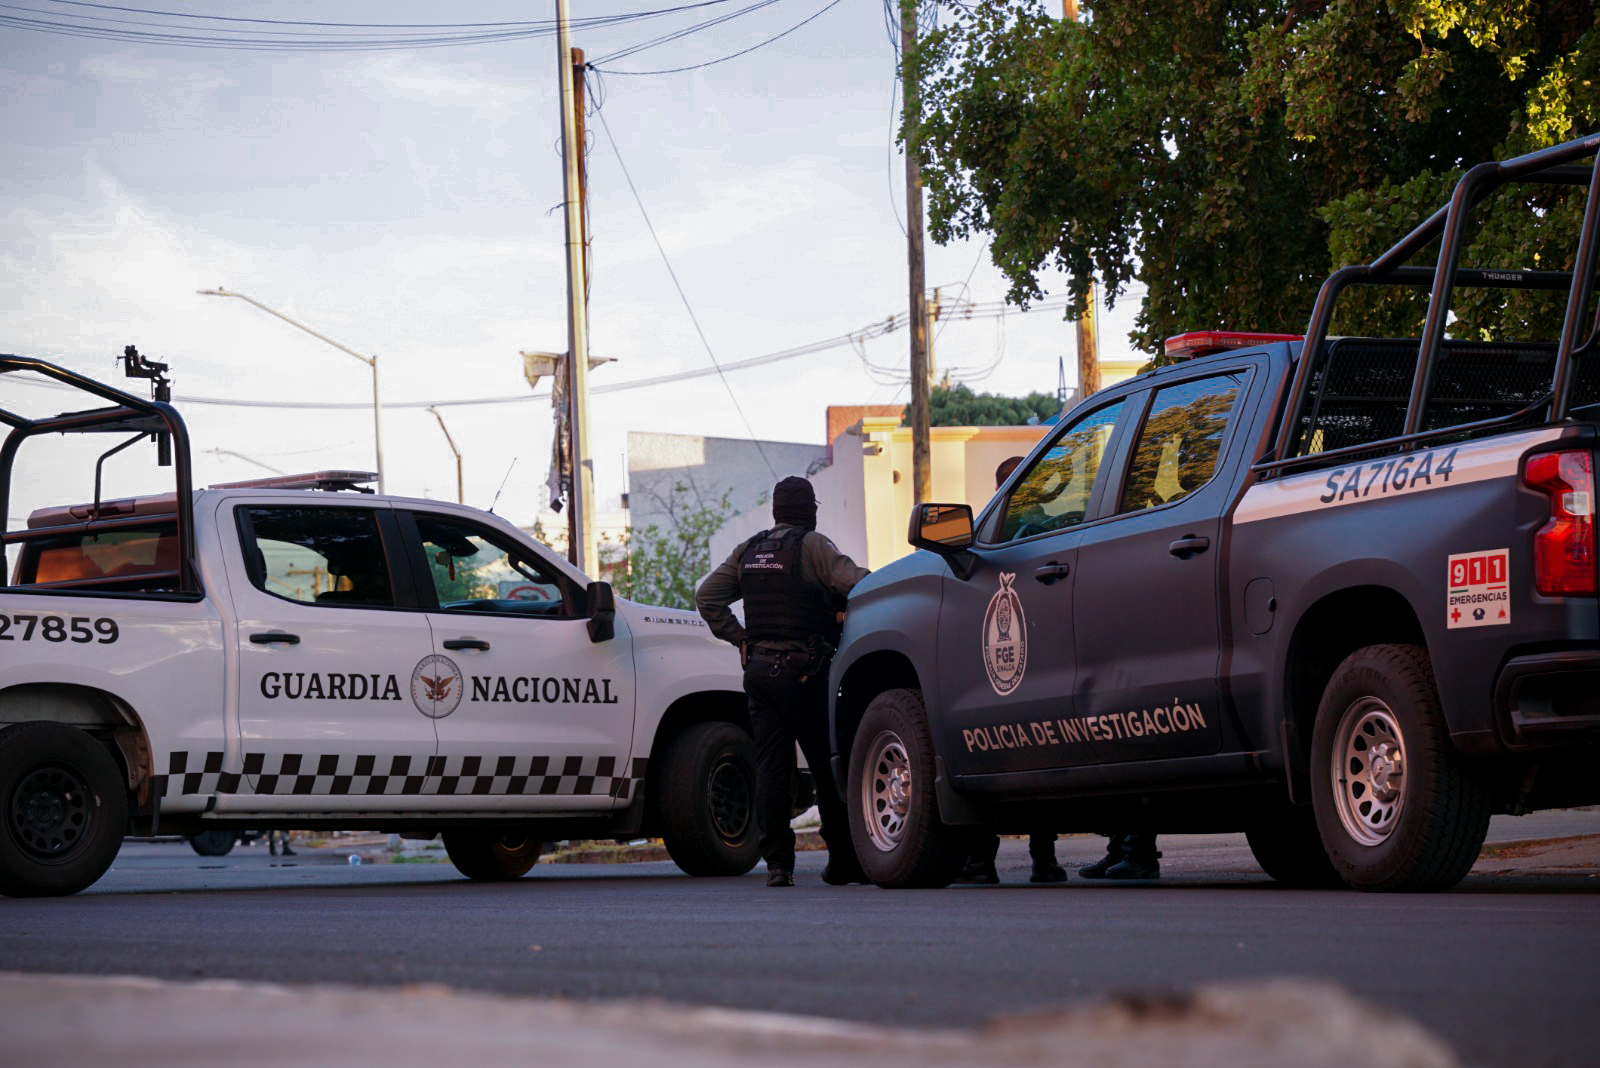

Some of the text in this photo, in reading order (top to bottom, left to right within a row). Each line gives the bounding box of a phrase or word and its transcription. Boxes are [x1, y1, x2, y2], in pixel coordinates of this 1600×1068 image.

[1482, 272, 1523, 281] THUNDER
[1320, 448, 1459, 503] SA716A4
[744, 562, 783, 570] INVESTIGACIÓN
[1454, 559, 1501, 584] 911
[1449, 591, 1508, 606] EMERGENCIAS
[0, 614, 119, 644] 27859
[995, 646, 1015, 664] FGE
[1017, 640, 1025, 674] ESTADO
[260, 671, 618, 704] GUARDIA NACIONAL
[963, 697, 1206, 752] POLICIA DE INVESTIGACIÓN
